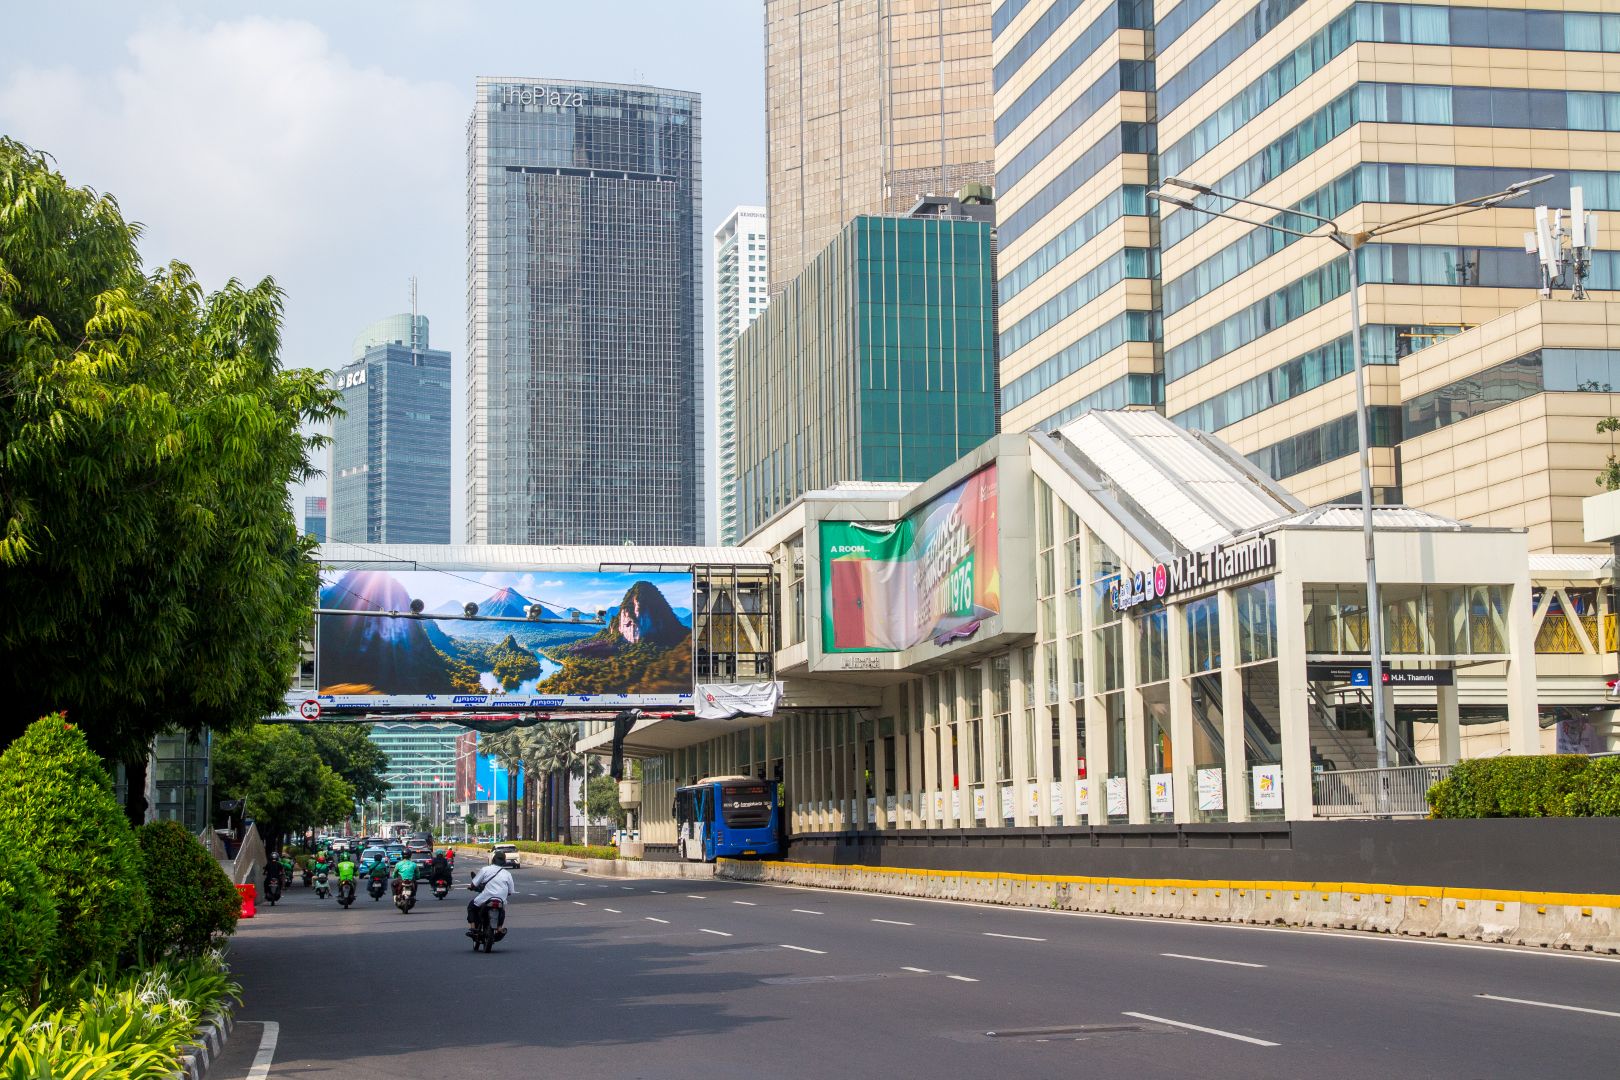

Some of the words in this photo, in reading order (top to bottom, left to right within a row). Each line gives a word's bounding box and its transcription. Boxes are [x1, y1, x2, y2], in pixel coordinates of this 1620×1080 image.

[345, 369, 366, 388] BCA
[830, 545, 838, 553] A
[1202, 531, 1273, 583] Thamrin
[950, 561, 972, 612] 1976
